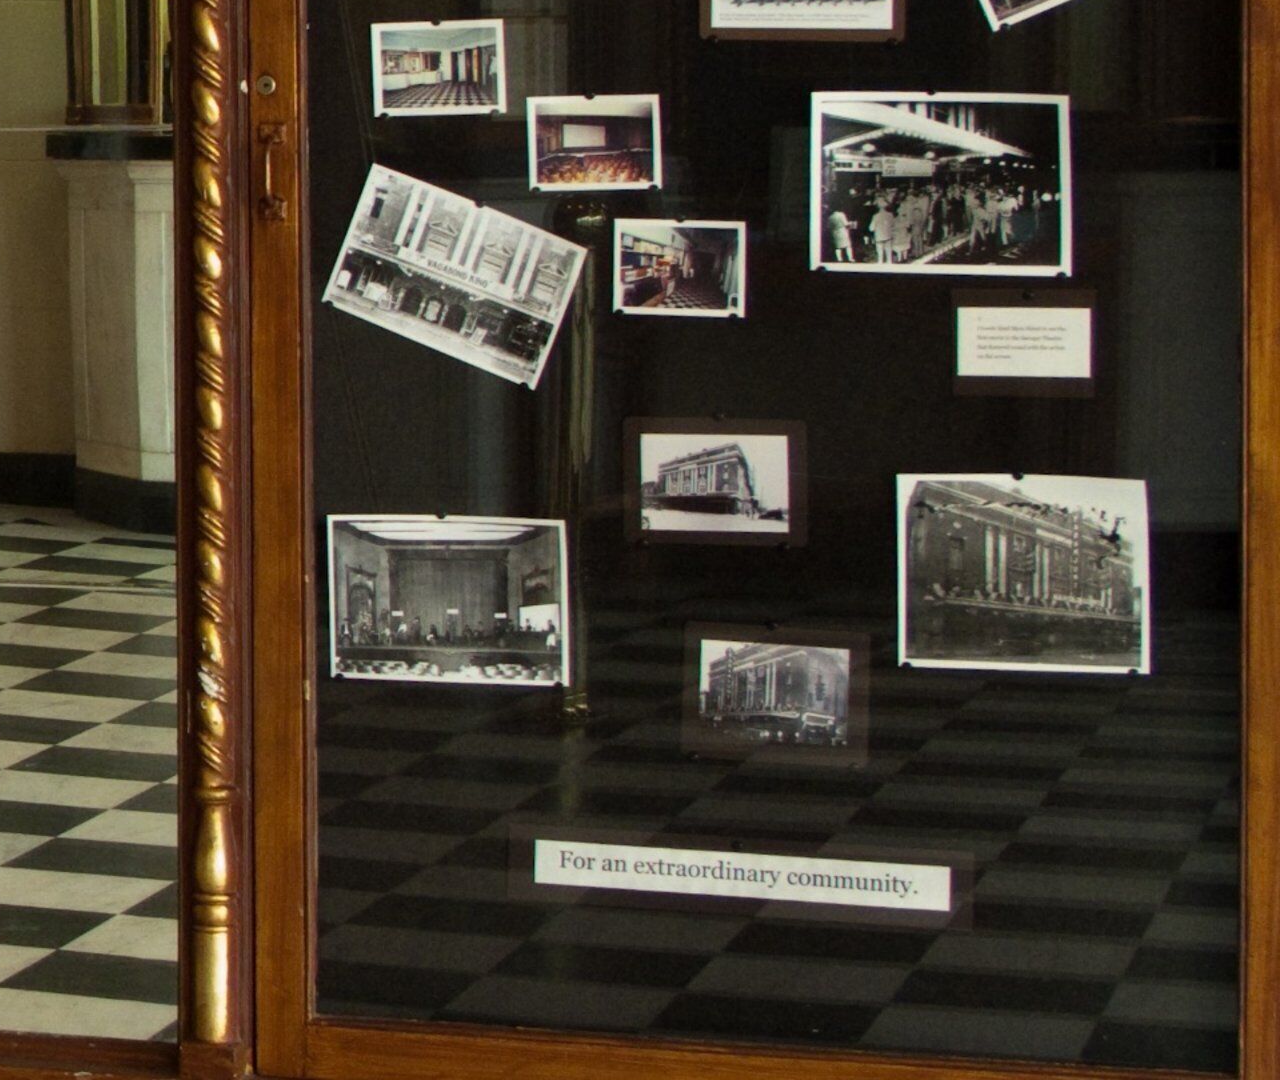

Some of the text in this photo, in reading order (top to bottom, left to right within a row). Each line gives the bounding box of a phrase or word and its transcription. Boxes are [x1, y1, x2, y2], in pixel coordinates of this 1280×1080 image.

[558, 850, 920, 899] For an extraordinary community.
